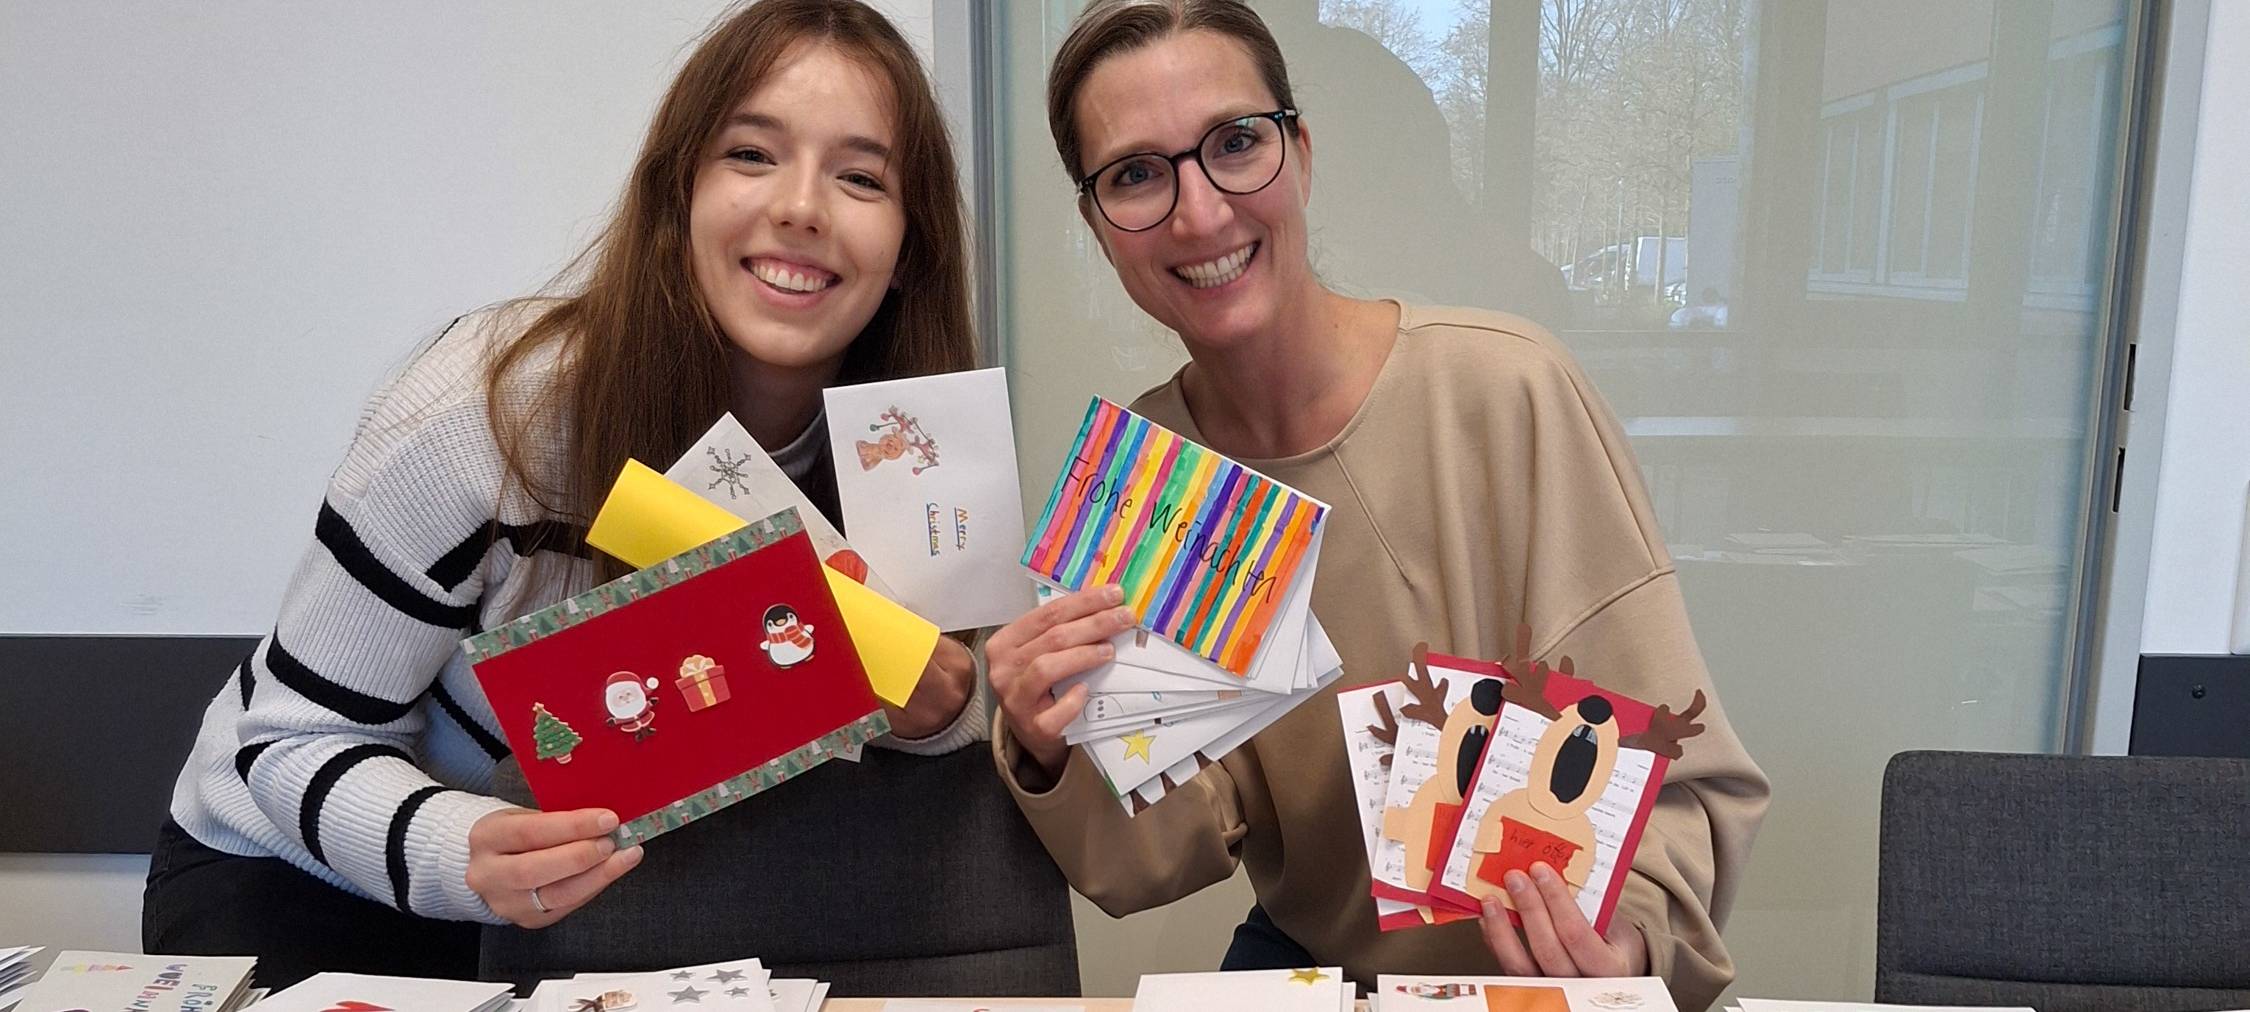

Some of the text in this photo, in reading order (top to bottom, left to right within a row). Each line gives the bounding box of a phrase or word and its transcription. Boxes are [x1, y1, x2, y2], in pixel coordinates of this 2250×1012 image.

[927, 502, 940, 556] Christmas
[955, 507, 968, 551] Merry
[1061, 456, 1277, 603] Frohe Weinachten
